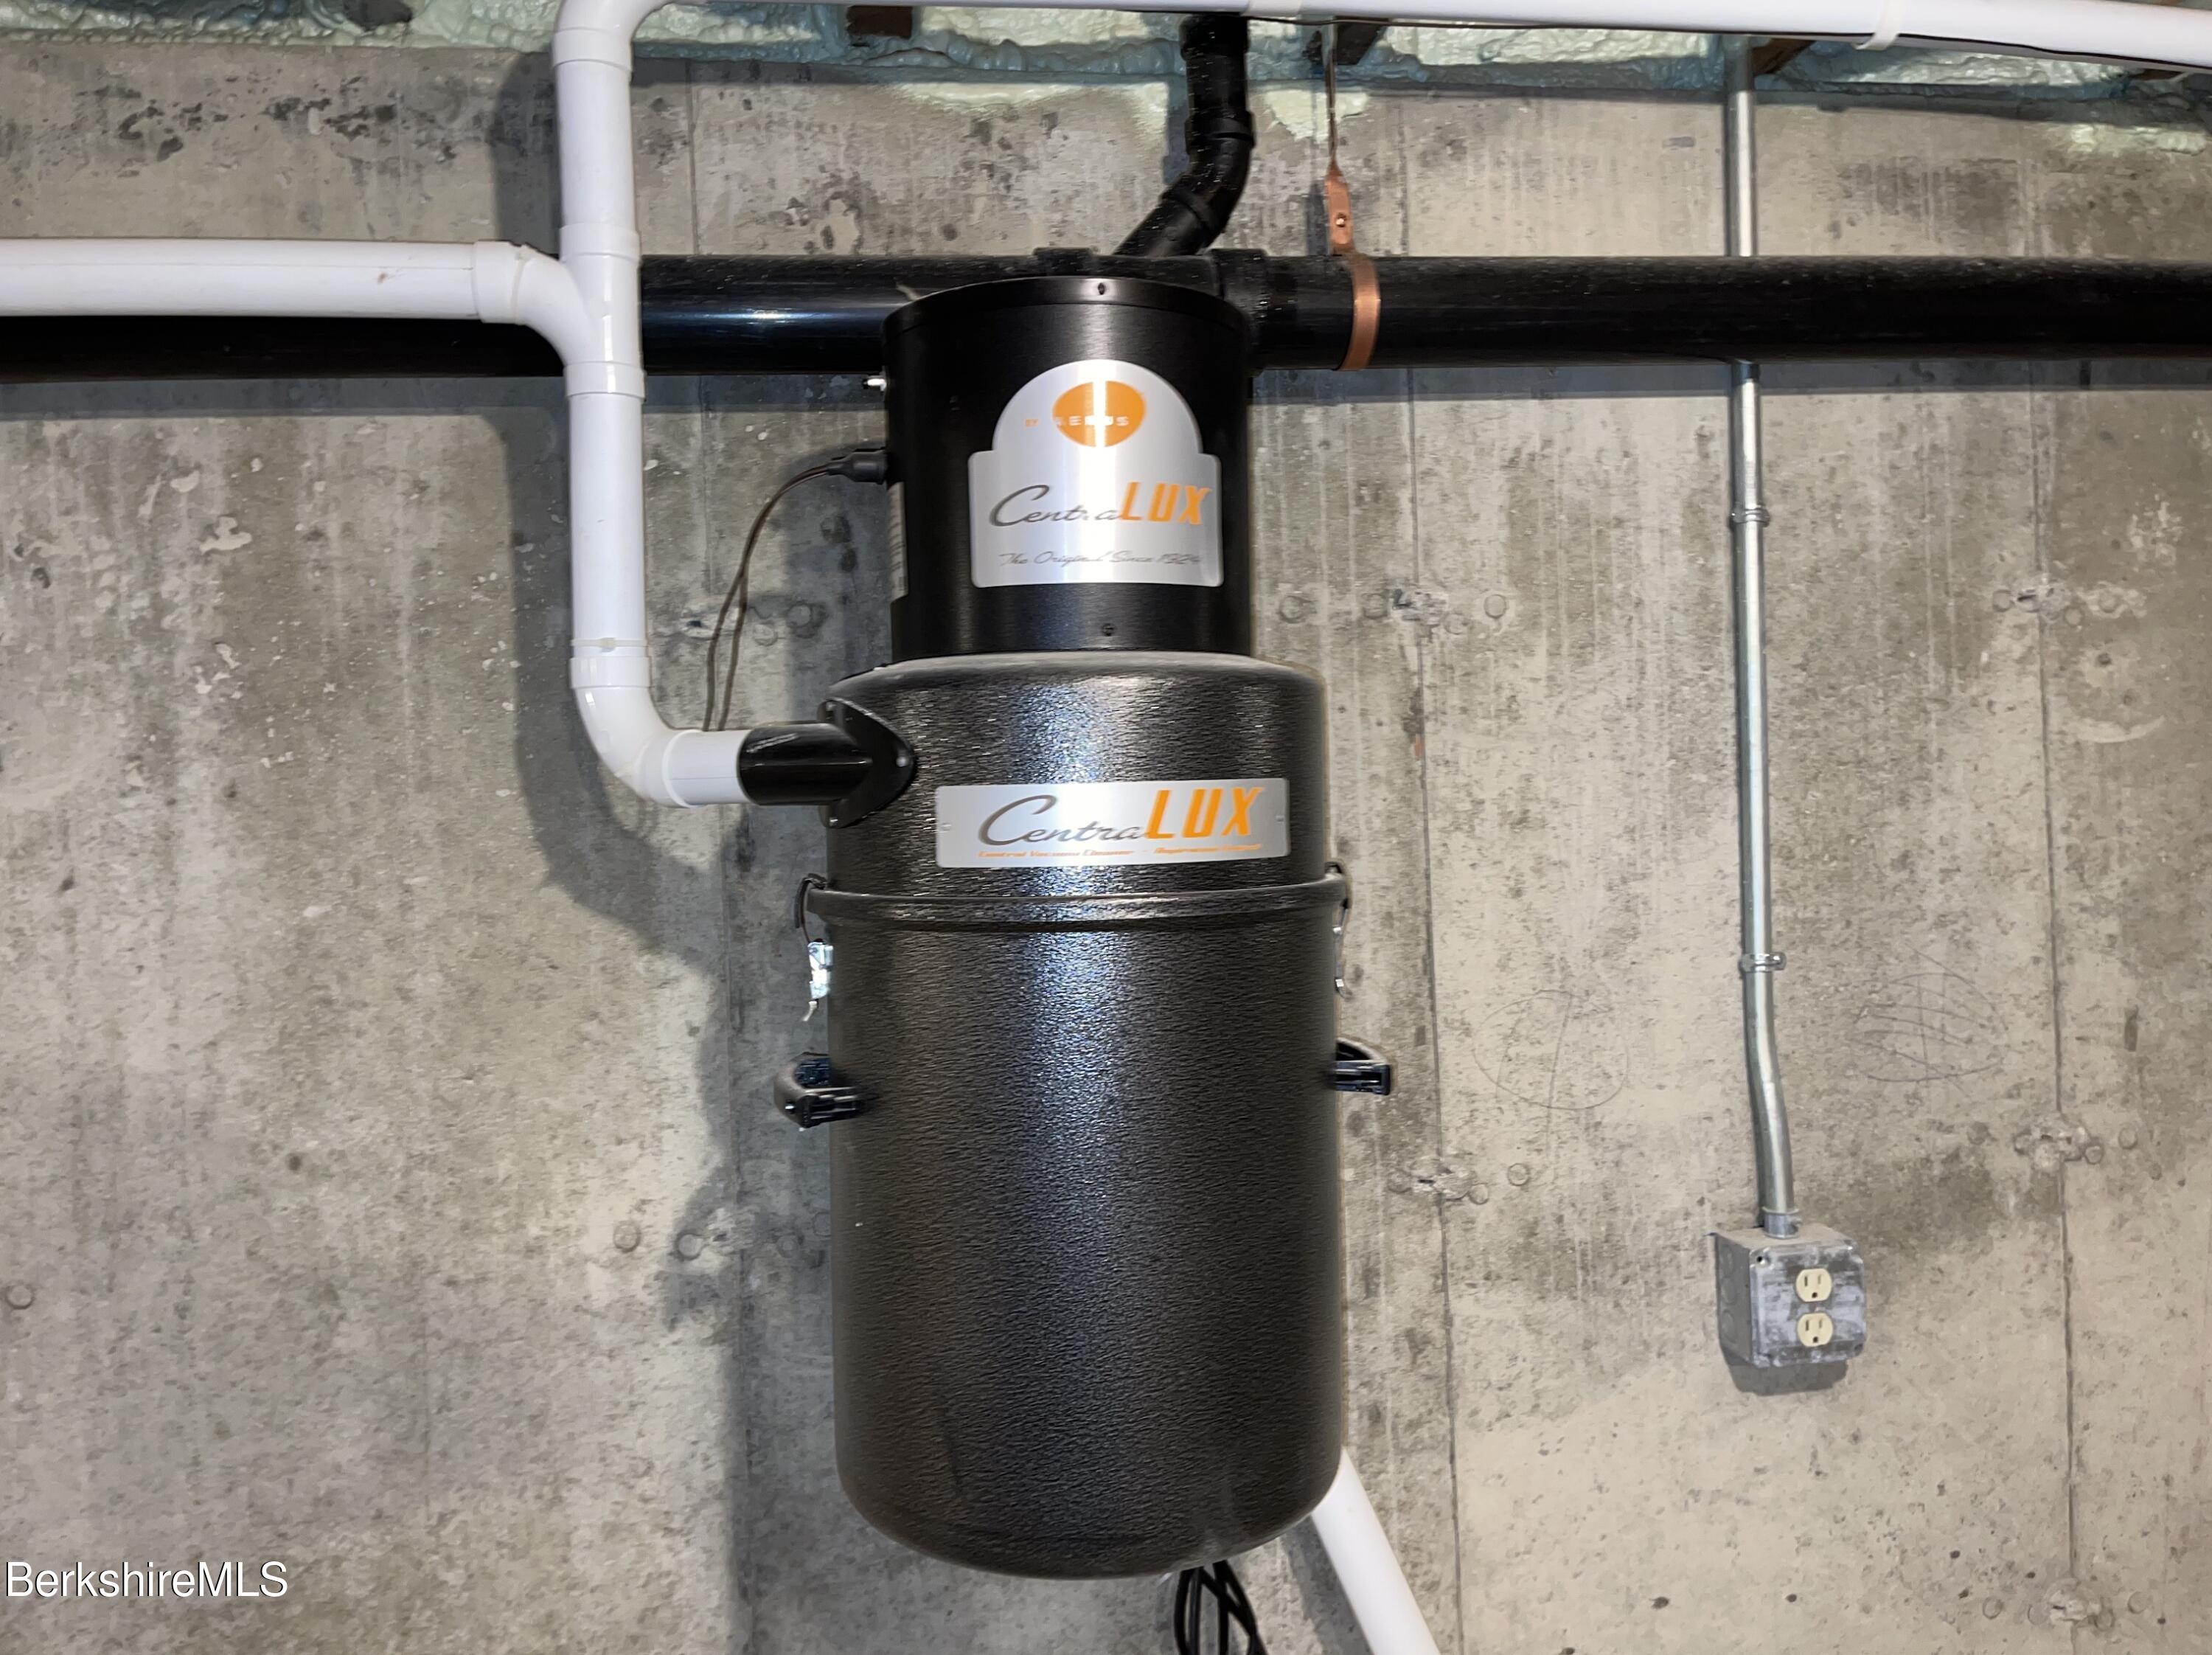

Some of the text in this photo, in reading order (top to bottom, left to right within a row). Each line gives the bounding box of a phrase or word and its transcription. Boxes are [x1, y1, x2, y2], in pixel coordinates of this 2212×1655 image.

[990, 482, 1211, 527] CentraLUX
[998, 552, 1028, 566] The
[1034, 551, 1114, 567] Original
[1109, 550, 1152, 563] Since
[979, 788, 1263, 846] CentraLUX
